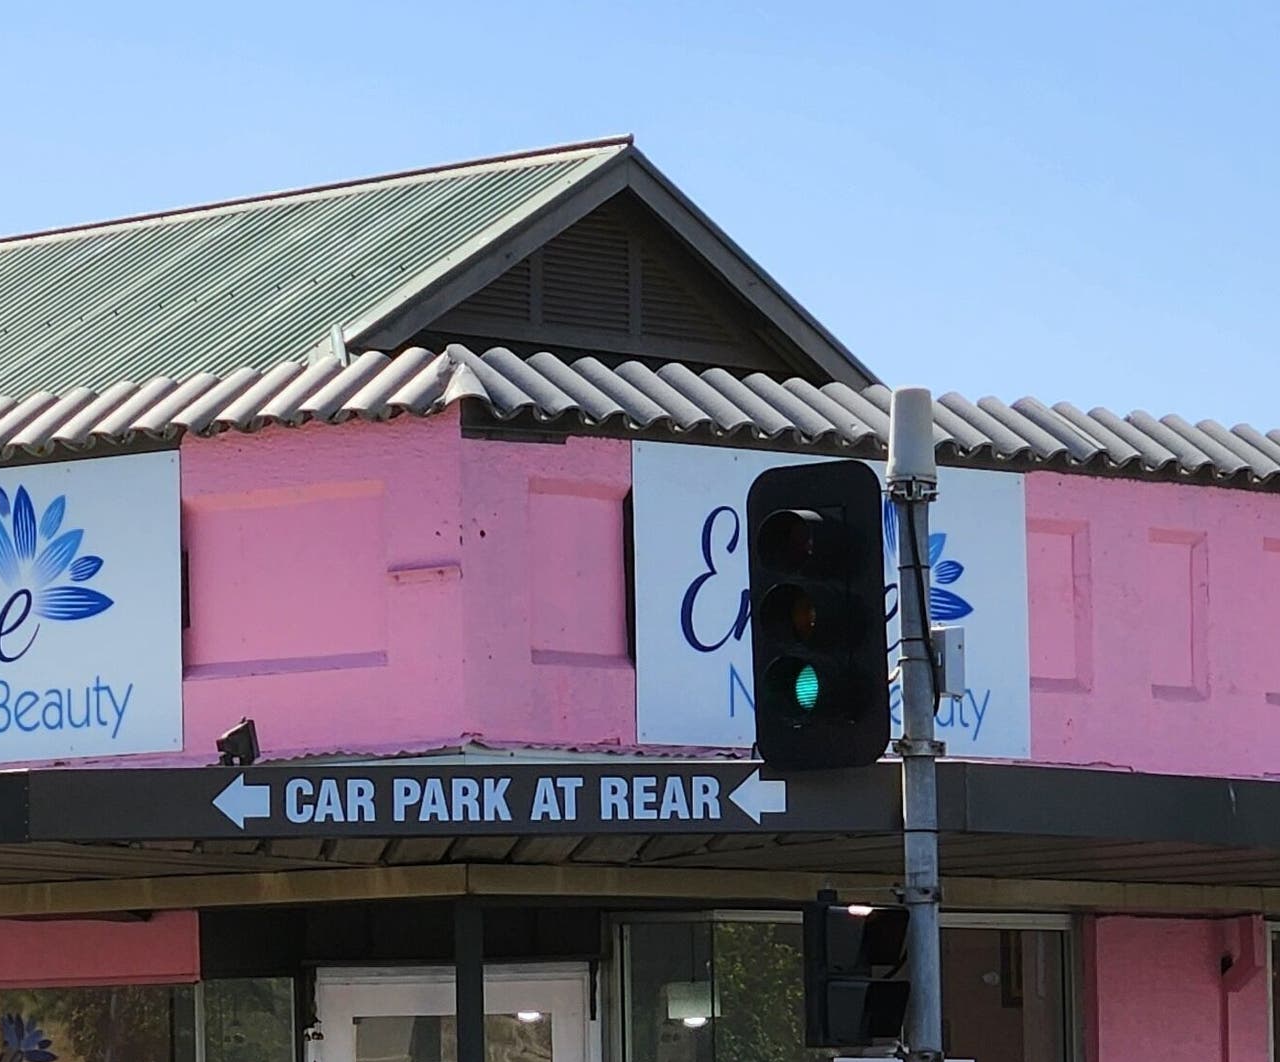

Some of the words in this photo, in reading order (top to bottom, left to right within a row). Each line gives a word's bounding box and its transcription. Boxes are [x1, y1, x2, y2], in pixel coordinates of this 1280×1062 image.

[284, 778, 376, 823] CAR
[392, 778, 513, 822] PARK
[530, 777, 584, 821] AT
[600, 776, 721, 820] REAR
